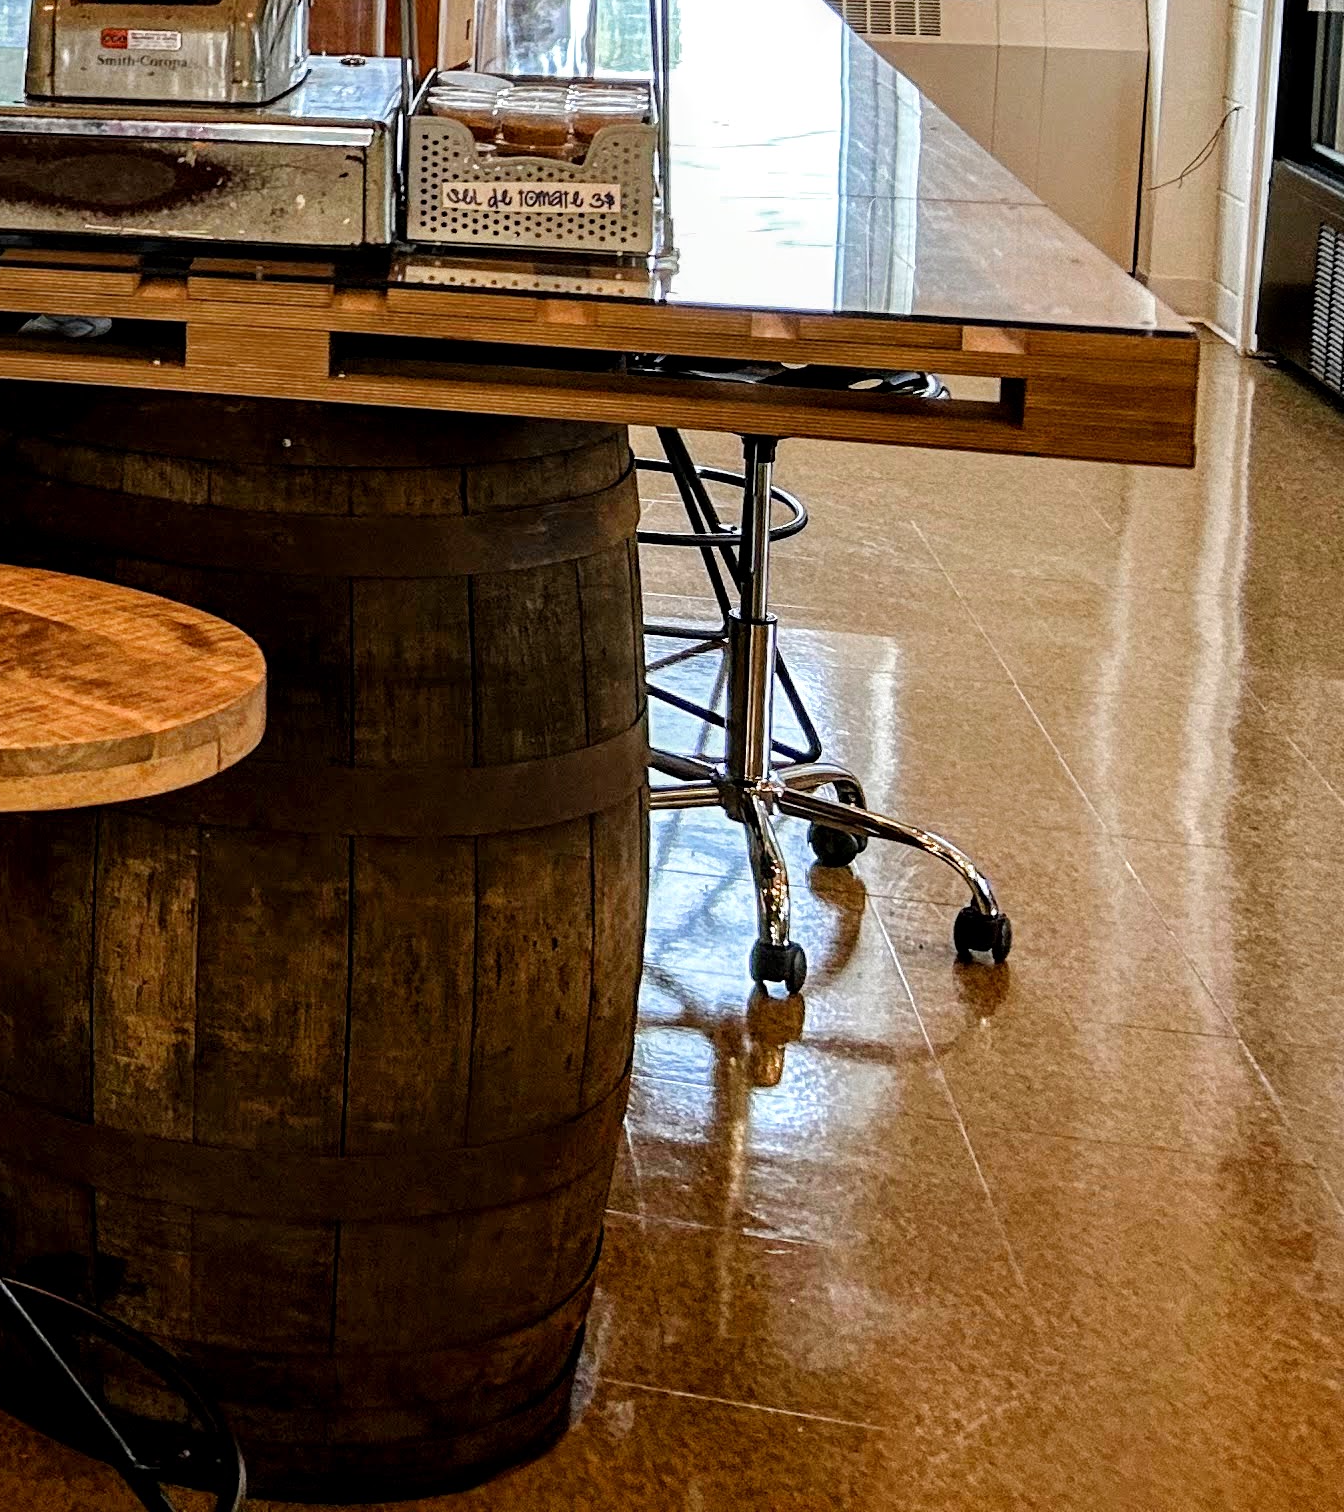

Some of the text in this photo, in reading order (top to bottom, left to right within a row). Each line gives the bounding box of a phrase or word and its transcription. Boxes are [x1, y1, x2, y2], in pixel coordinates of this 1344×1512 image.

[97, 55, 187, 68] Smith-Corona
[487, 188, 512, 209] de
[589, 191, 615, 210] 3$
